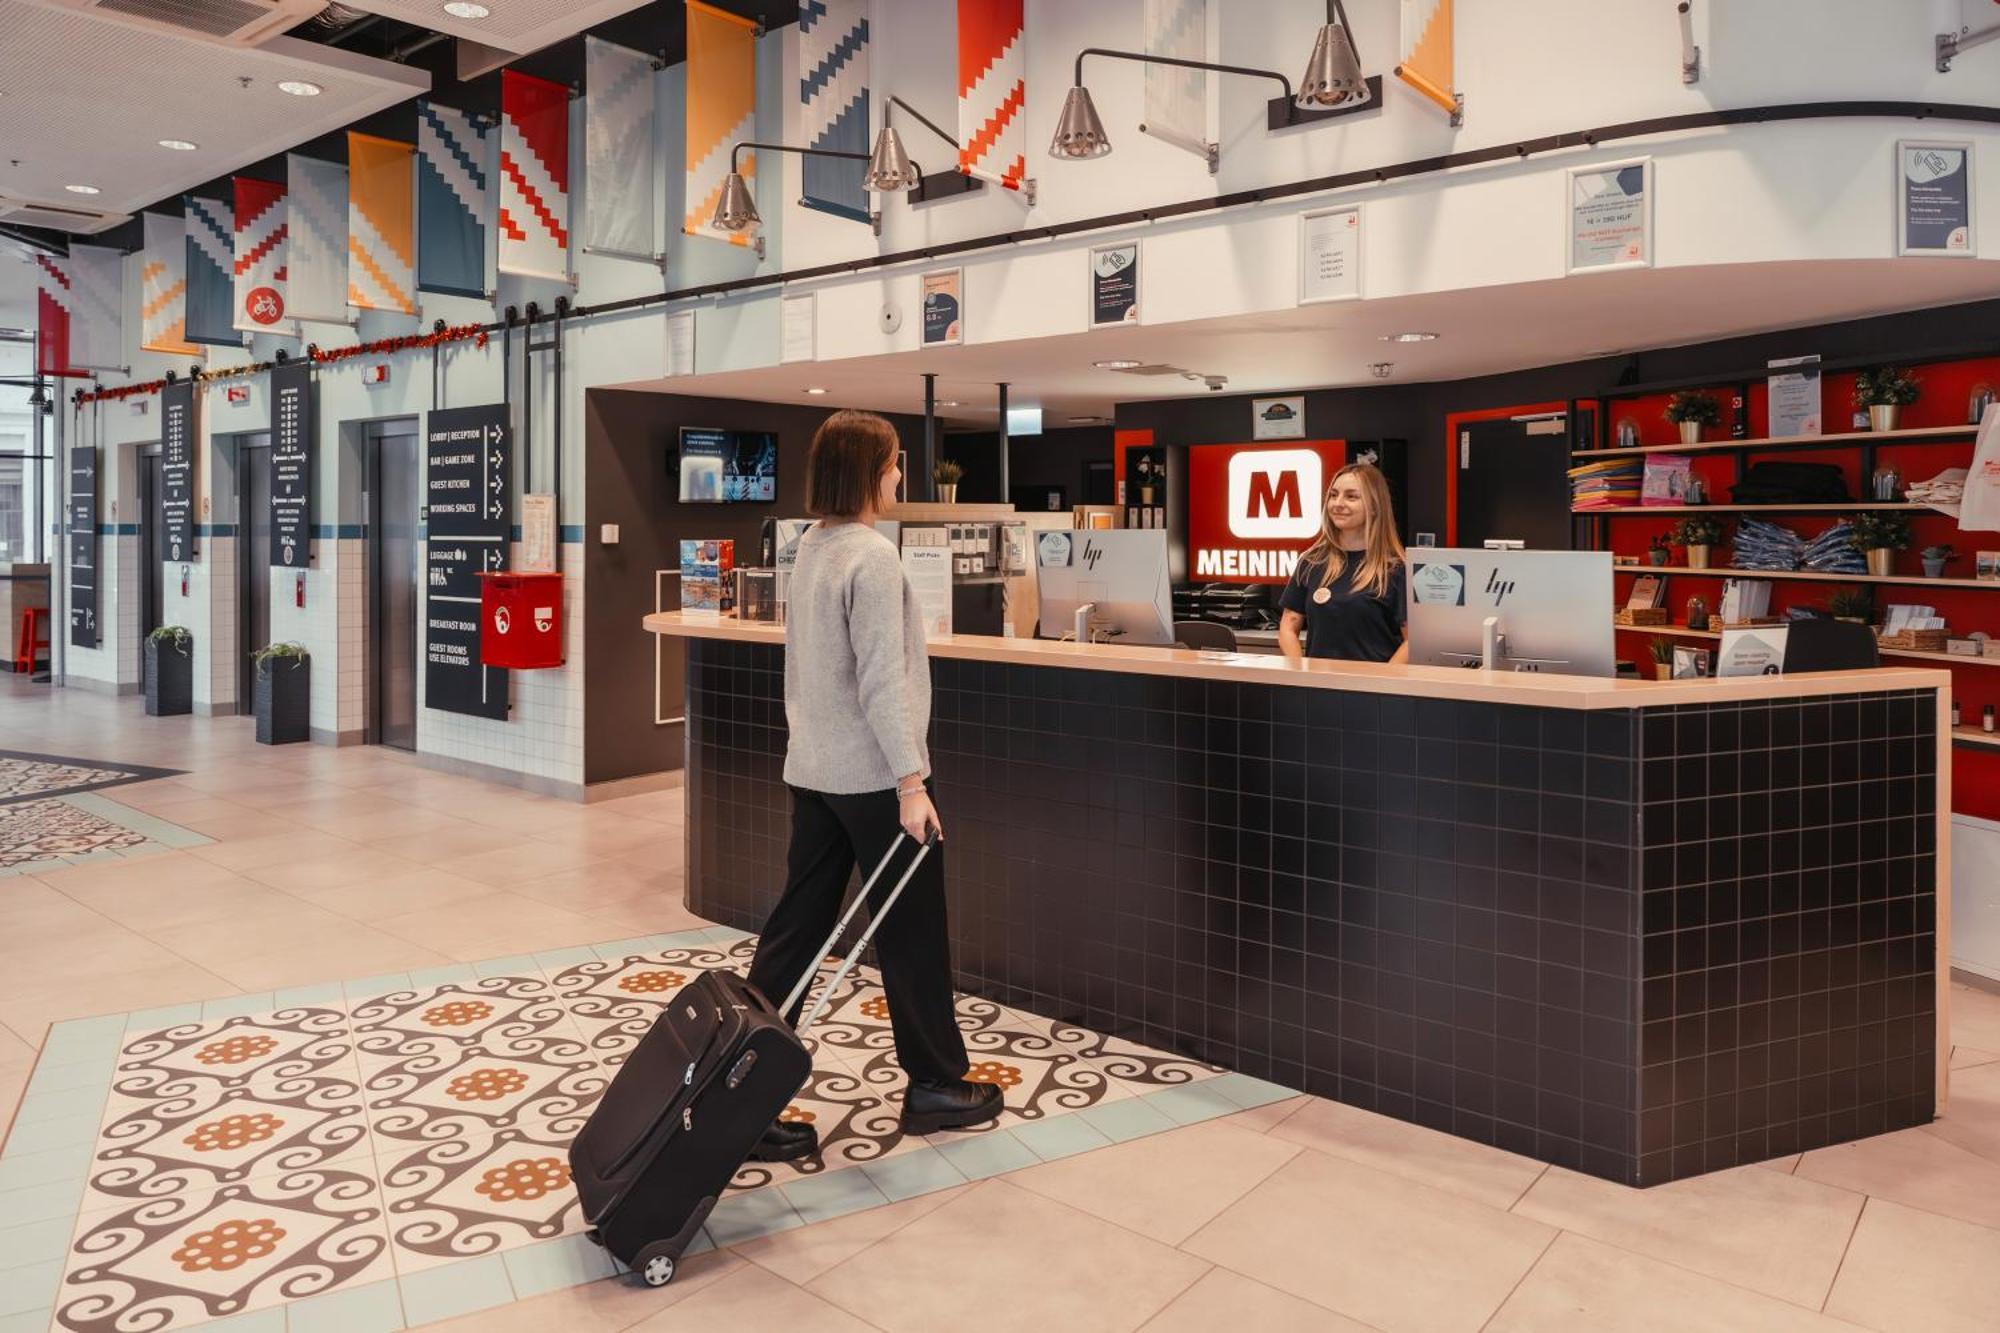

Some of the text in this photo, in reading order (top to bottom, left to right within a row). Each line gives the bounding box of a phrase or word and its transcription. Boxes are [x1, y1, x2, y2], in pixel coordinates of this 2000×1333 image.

[430, 432, 447, 442] LOBBY
[451, 429, 480, 441] RECEPTION
[430, 456, 441, 466] BAR
[445, 455, 460, 465] GAME
[460, 454, 475, 464] ZONE
[430, 479, 470, 490] GUEST KITCHEN
[1246, 470, 1303, 518] M
[430, 503, 476, 513] WORKING SPACES
[430, 550, 454, 561] LUGGAGE
[1083, 538, 1103, 571] hp
[1197, 549, 1299, 577] MEININ
[1485, 567, 1516, 607] hp
[429, 619, 477, 631] BREAKFAST ROOM
[429, 643, 467, 656] GUEST ROOMS
[429, 653, 470, 666] USE ELEVATORS
